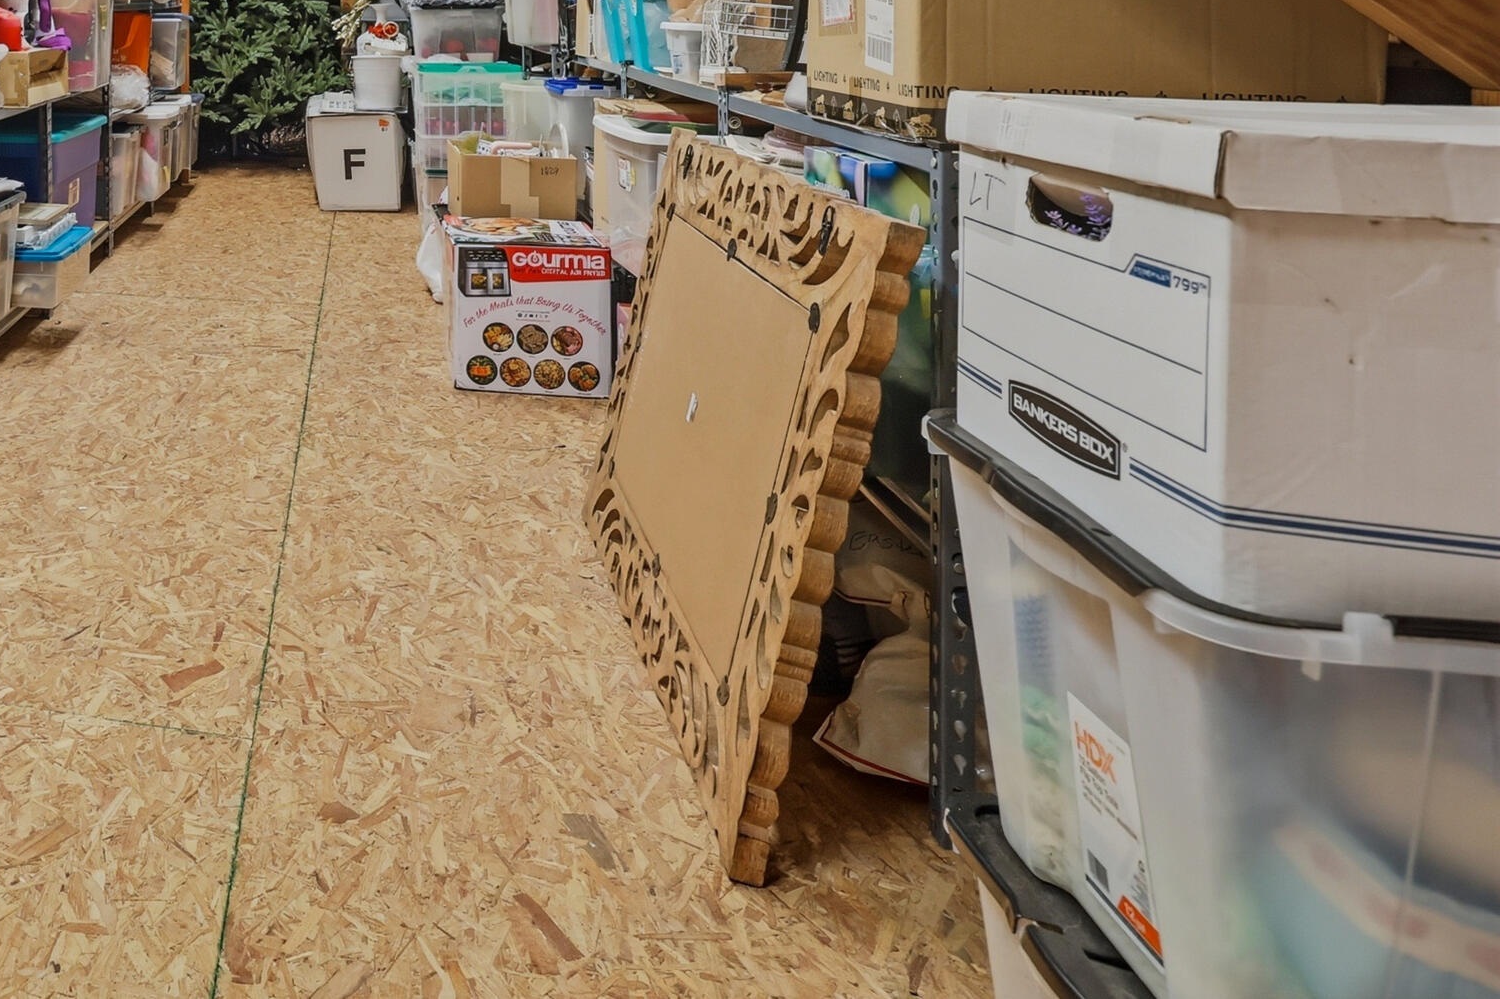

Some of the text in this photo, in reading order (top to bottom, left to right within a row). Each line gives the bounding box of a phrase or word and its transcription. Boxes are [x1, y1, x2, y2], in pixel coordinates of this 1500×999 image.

[813, 70, 838, 85] LIGHTING
[343, 148, 366, 180] F
[1013, 393, 1115, 465] BANKERS BOX
[1075, 720, 1117, 785] HDX
